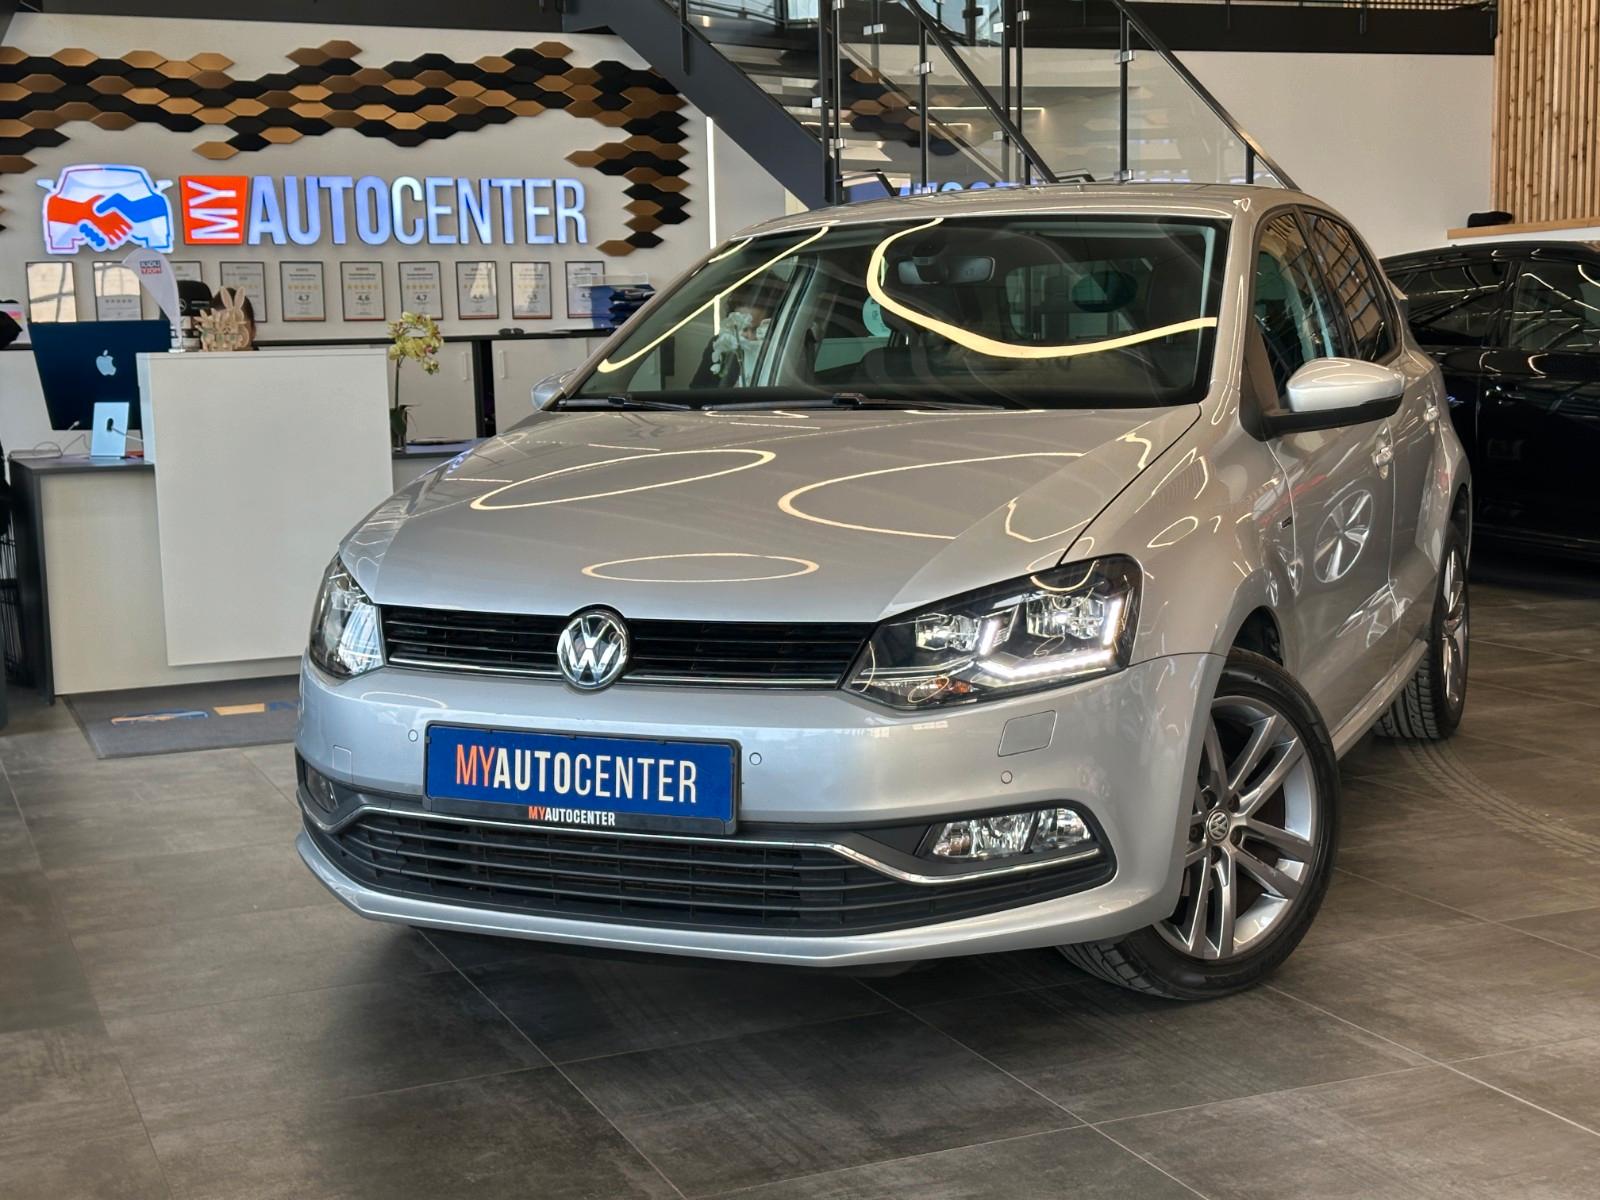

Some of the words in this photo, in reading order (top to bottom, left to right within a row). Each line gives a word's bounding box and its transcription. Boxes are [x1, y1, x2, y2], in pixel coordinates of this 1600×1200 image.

[187, 180, 240, 239] MY
[248, 175, 588, 245] AUTOCENTER
[456, 744, 697, 803] MYAUTOCENTER
[528, 806, 615, 826] MYAUTOCENTER
